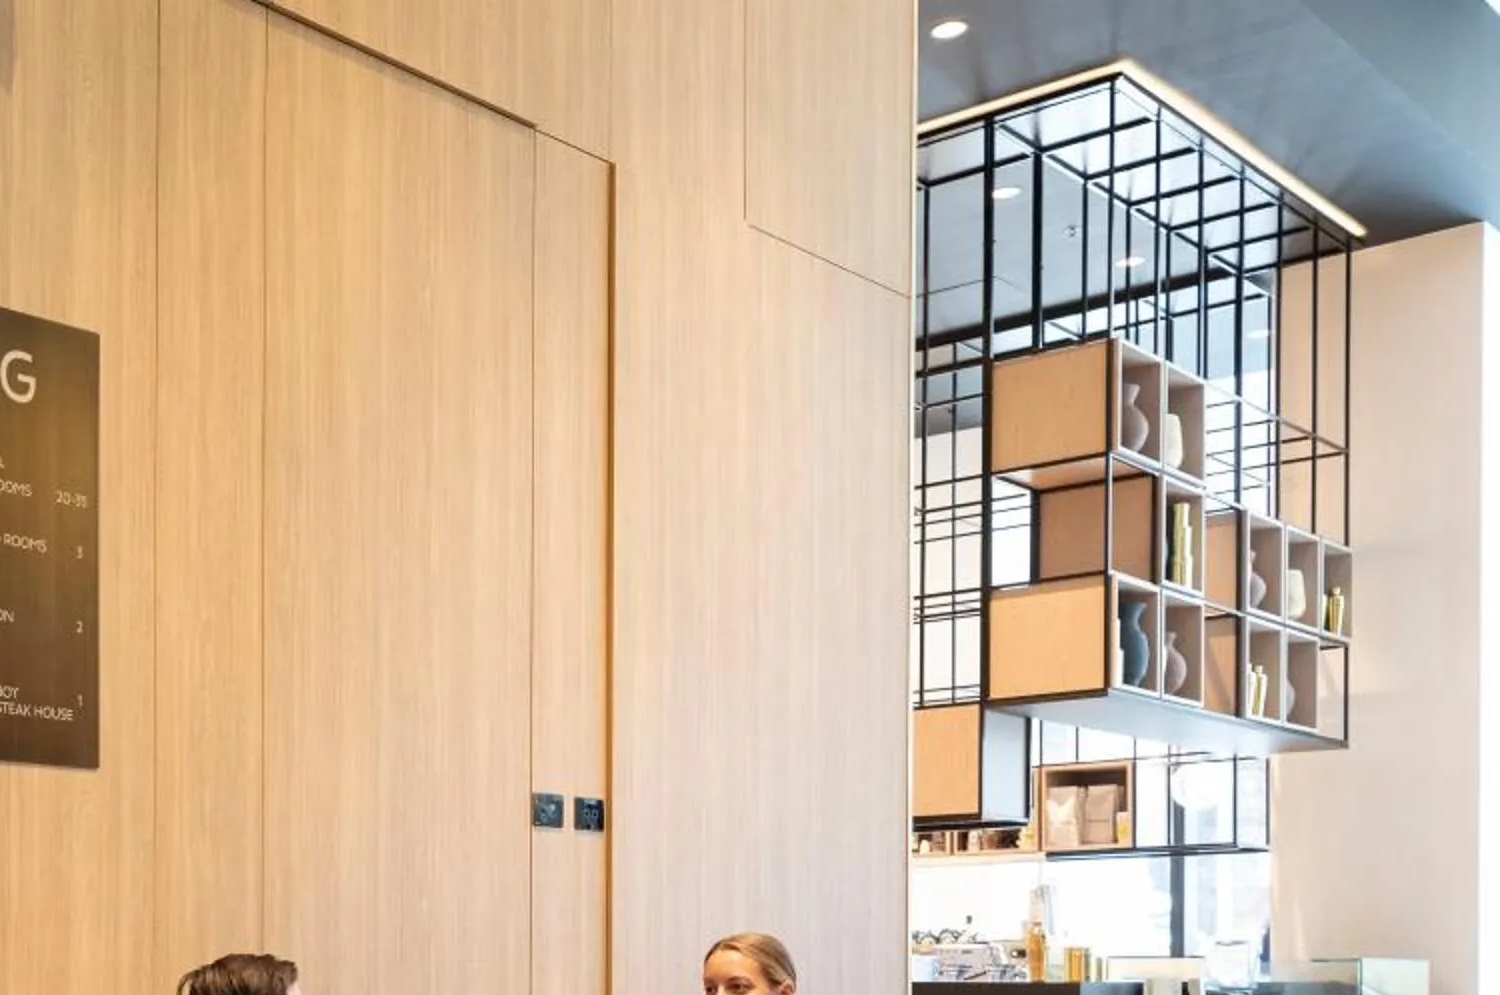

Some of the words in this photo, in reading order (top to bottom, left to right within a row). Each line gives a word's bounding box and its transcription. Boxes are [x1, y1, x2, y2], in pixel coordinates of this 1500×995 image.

[0, 349, 38, 404] G
[3, 532, 48, 554] ROOMS
[33, 706, 75, 721] HOUSE
